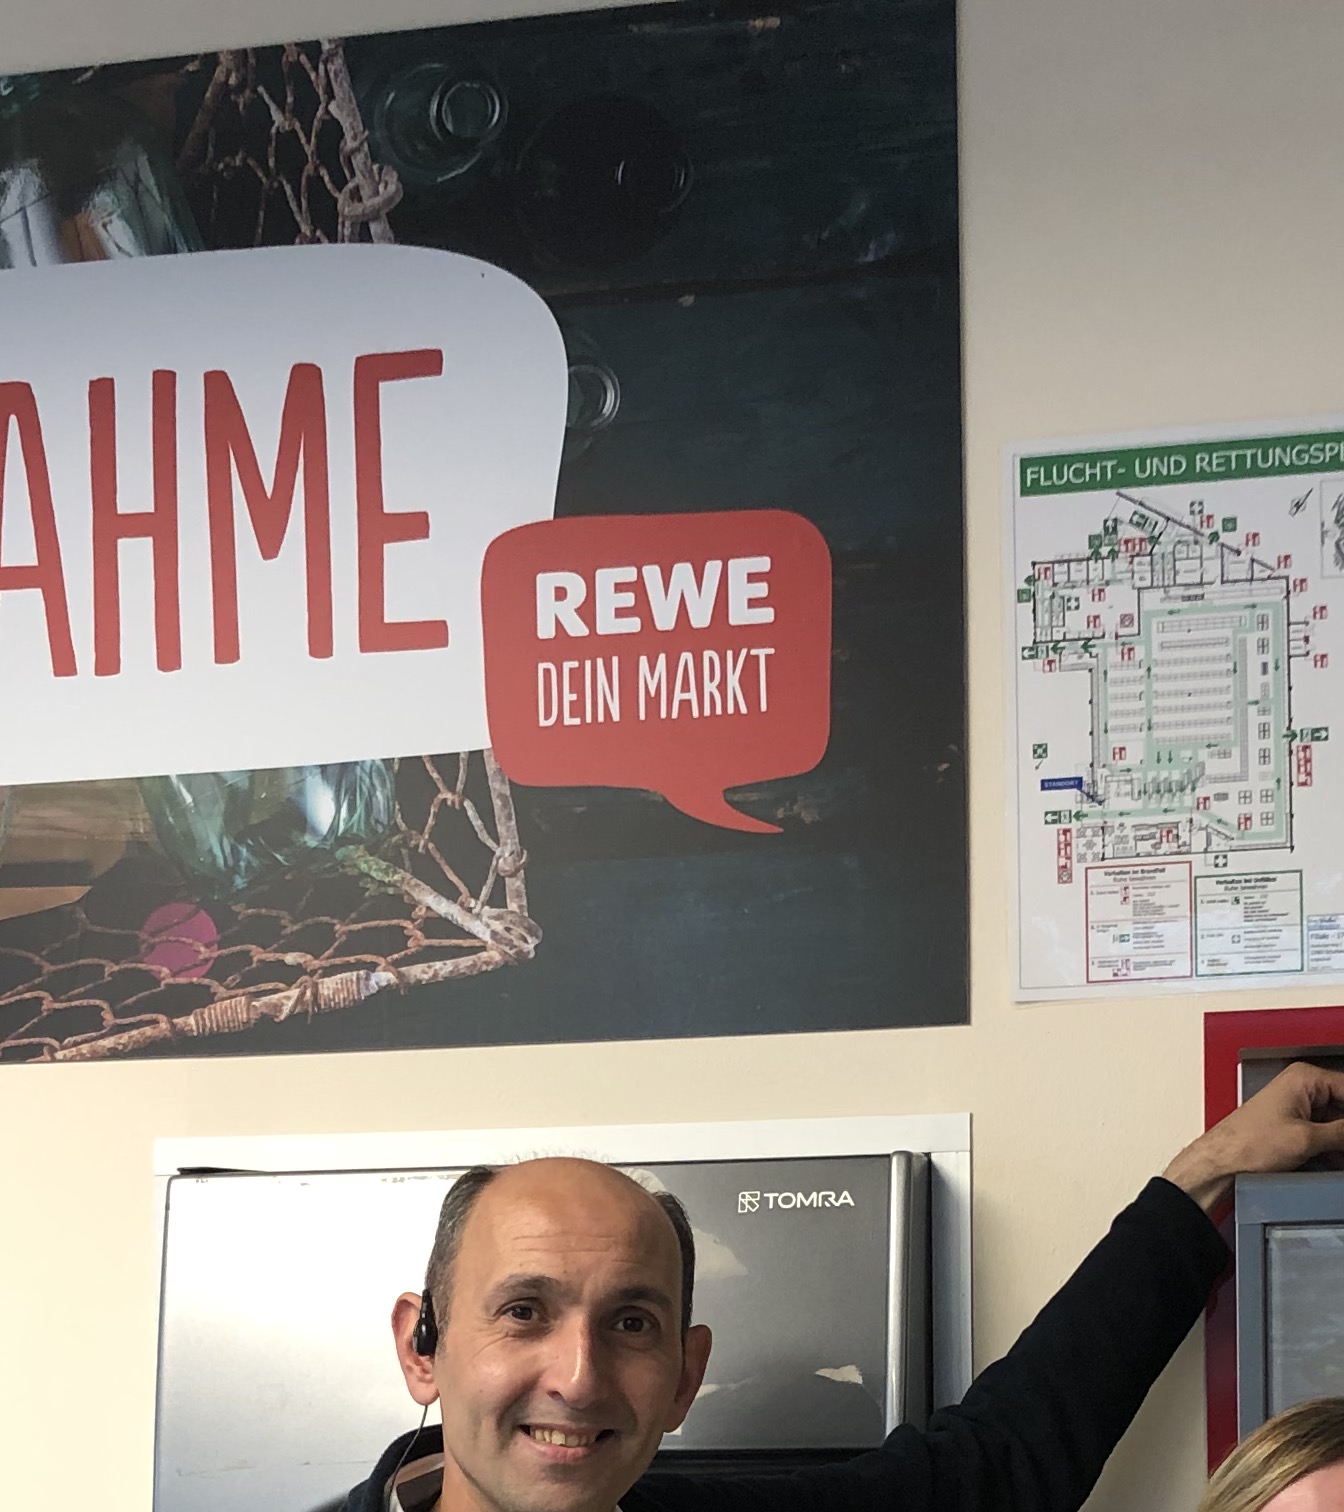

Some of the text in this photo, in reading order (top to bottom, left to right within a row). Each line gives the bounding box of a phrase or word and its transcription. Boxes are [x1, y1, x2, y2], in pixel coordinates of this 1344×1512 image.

[1025, 459, 1125, 488] FLUCHT-
[1134, 453, 1187, 480] UND
[535, 555, 776, 640] REWE
[537, 647, 776, 727] DEIN MARKT
[763, 1190, 856, 1209] TOMRA
